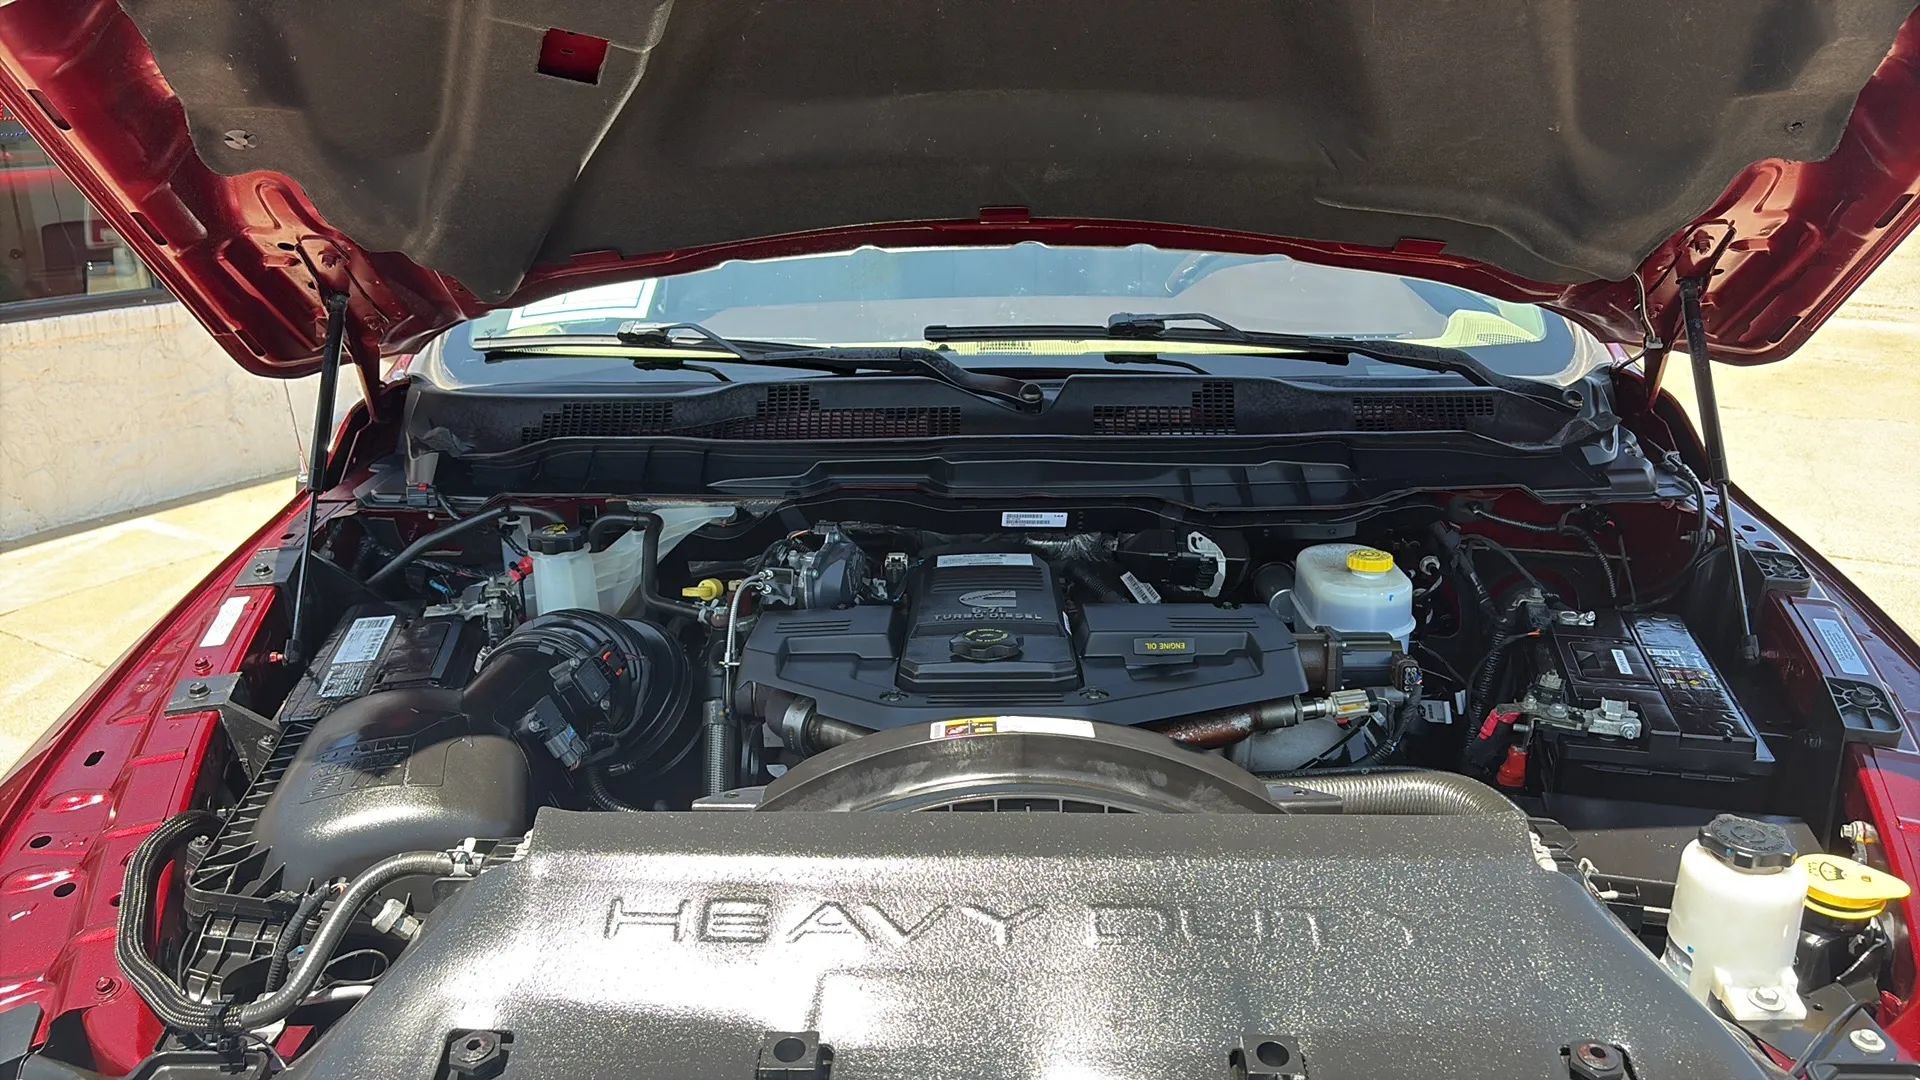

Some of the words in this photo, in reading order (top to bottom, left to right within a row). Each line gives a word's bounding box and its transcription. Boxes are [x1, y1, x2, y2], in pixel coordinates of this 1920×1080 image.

[1144, 642, 1158, 650] OIL
[1160, 642, 1186, 650] ENGINE
[604, 898, 1049, 944] HEAVY
